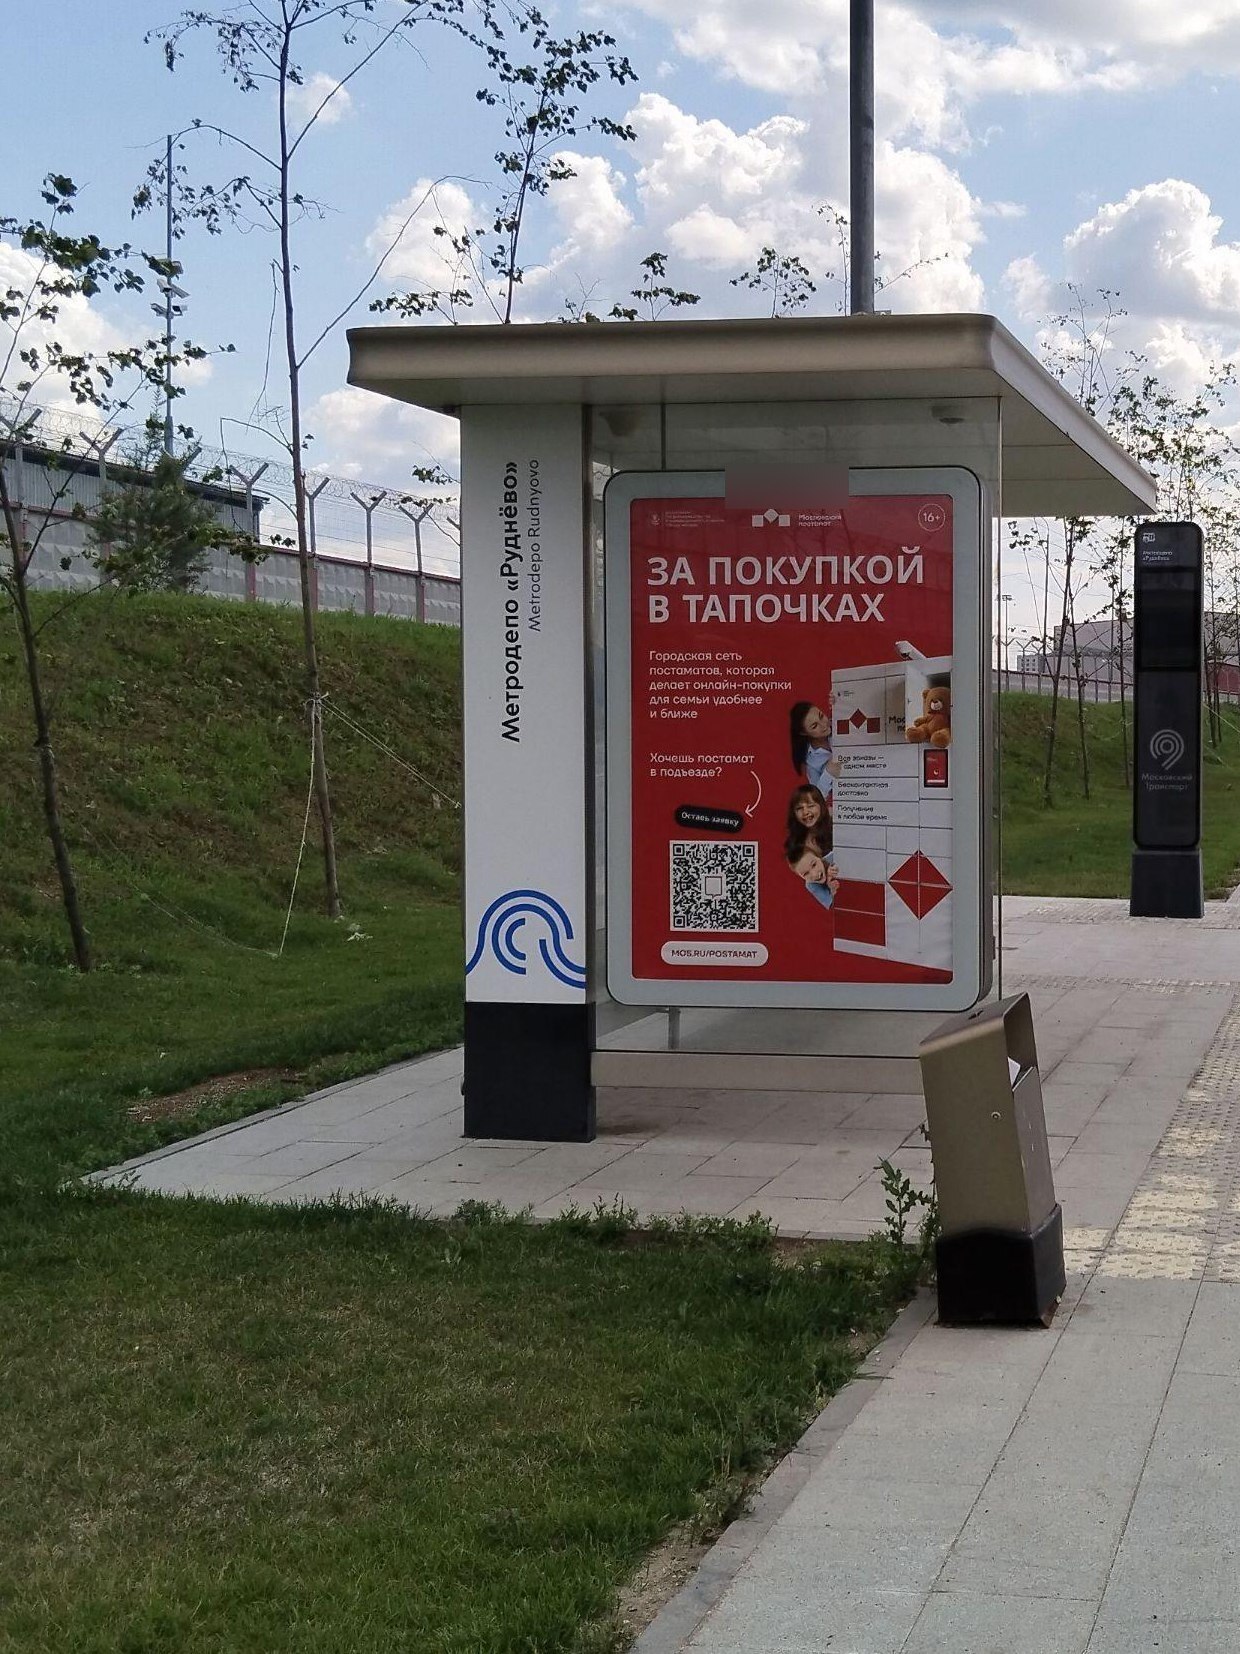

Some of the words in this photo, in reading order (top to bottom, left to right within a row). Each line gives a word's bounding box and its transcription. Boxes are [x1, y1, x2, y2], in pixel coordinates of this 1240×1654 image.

[527, 459, 544, 538] Rudnyovo
[923, 512, 941, 523] 16+
[499, 461, 524, 591] «Руднёво»
[647, 556, 696, 586] ЗА
[709, 546, 924, 585] ПОКУПКОЙ
[527, 542, 544, 632] Metrodepo
[649, 594, 670, 623] В
[682, 593, 885, 623] ТАПОЧКАХ
[649, 650, 712, 663] Городская
[715, 651, 743, 662] сеть
[501, 599, 524, 743] Метродепо
[649, 667, 723, 678] постаматов,
[726, 666, 775, 678] которая
[649, 681, 691, 692] делает
[693, 679, 792, 692] онлайн-покупки
[649, 696, 670, 706] для
[672, 695, 710, 706] семьи
[712, 694, 763, 707] удобнее
[649, 710, 657, 719] и
[660, 708, 698, 720] ближе
[650, 752, 695, 763] Хочешь
[697, 754, 755, 765] постамат
[650, 768, 657, 777] в
[660, 766, 723, 779] подъезде?
[681, 811, 710, 822] Оставь
[671, 949, 758, 959] MOS.RU/POSTAMAT
